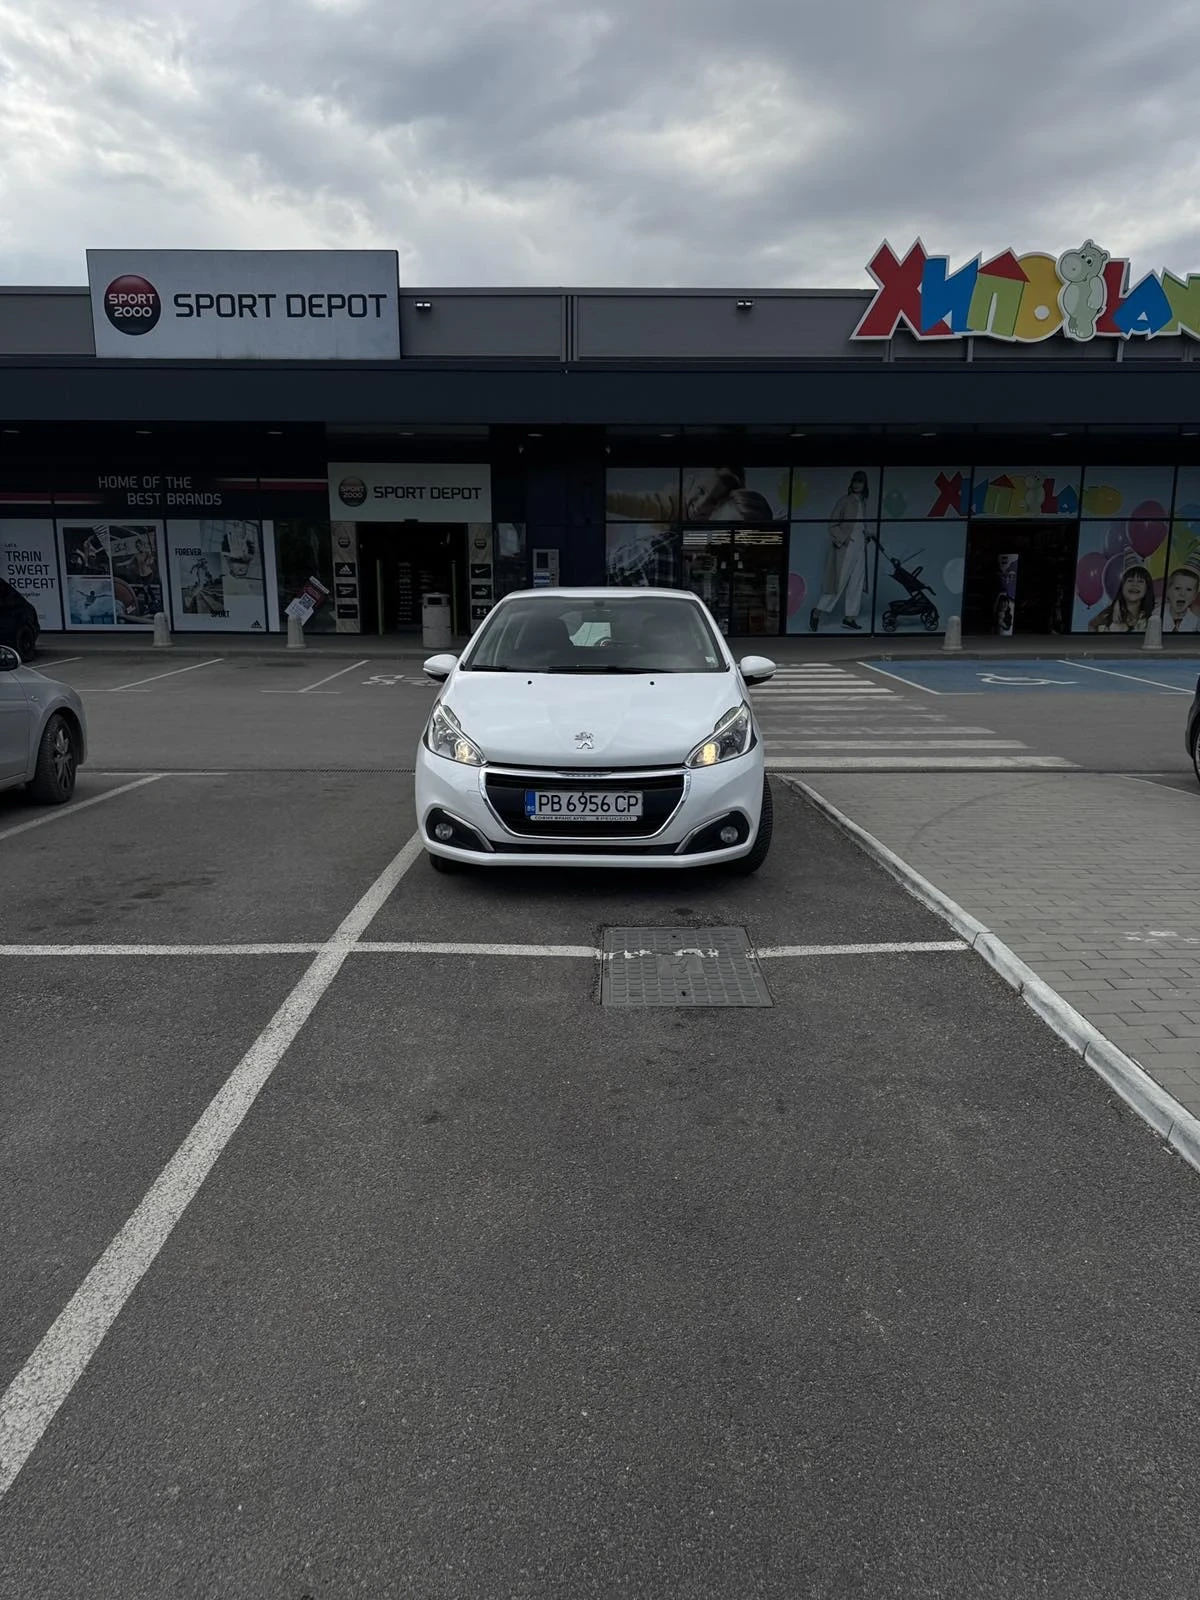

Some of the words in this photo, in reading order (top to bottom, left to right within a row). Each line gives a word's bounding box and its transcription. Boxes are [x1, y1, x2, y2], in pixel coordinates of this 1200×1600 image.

[108, 293, 155, 305] SPORT
[173, 293, 277, 318] SPORT
[286, 294, 388, 318] DEPOT
[113, 306, 153, 318] 2000
[97, 475, 138, 488] HOME
[143, 475, 160, 488] OF
[165, 476, 192, 489] THE
[127, 492, 161, 505] BEST
[167, 493, 222, 505] BRANDS
[373, 486, 426, 499] SPORT
[430, 487, 482, 499] DEPOT
[5, 551, 42, 562] TRAIN
[175, 548, 202, 556] FOREVER
[8, 564, 49, 575] SWEAT
[9, 577, 56, 589] REPEAT
[210, 610, 230, 618] SPORT
